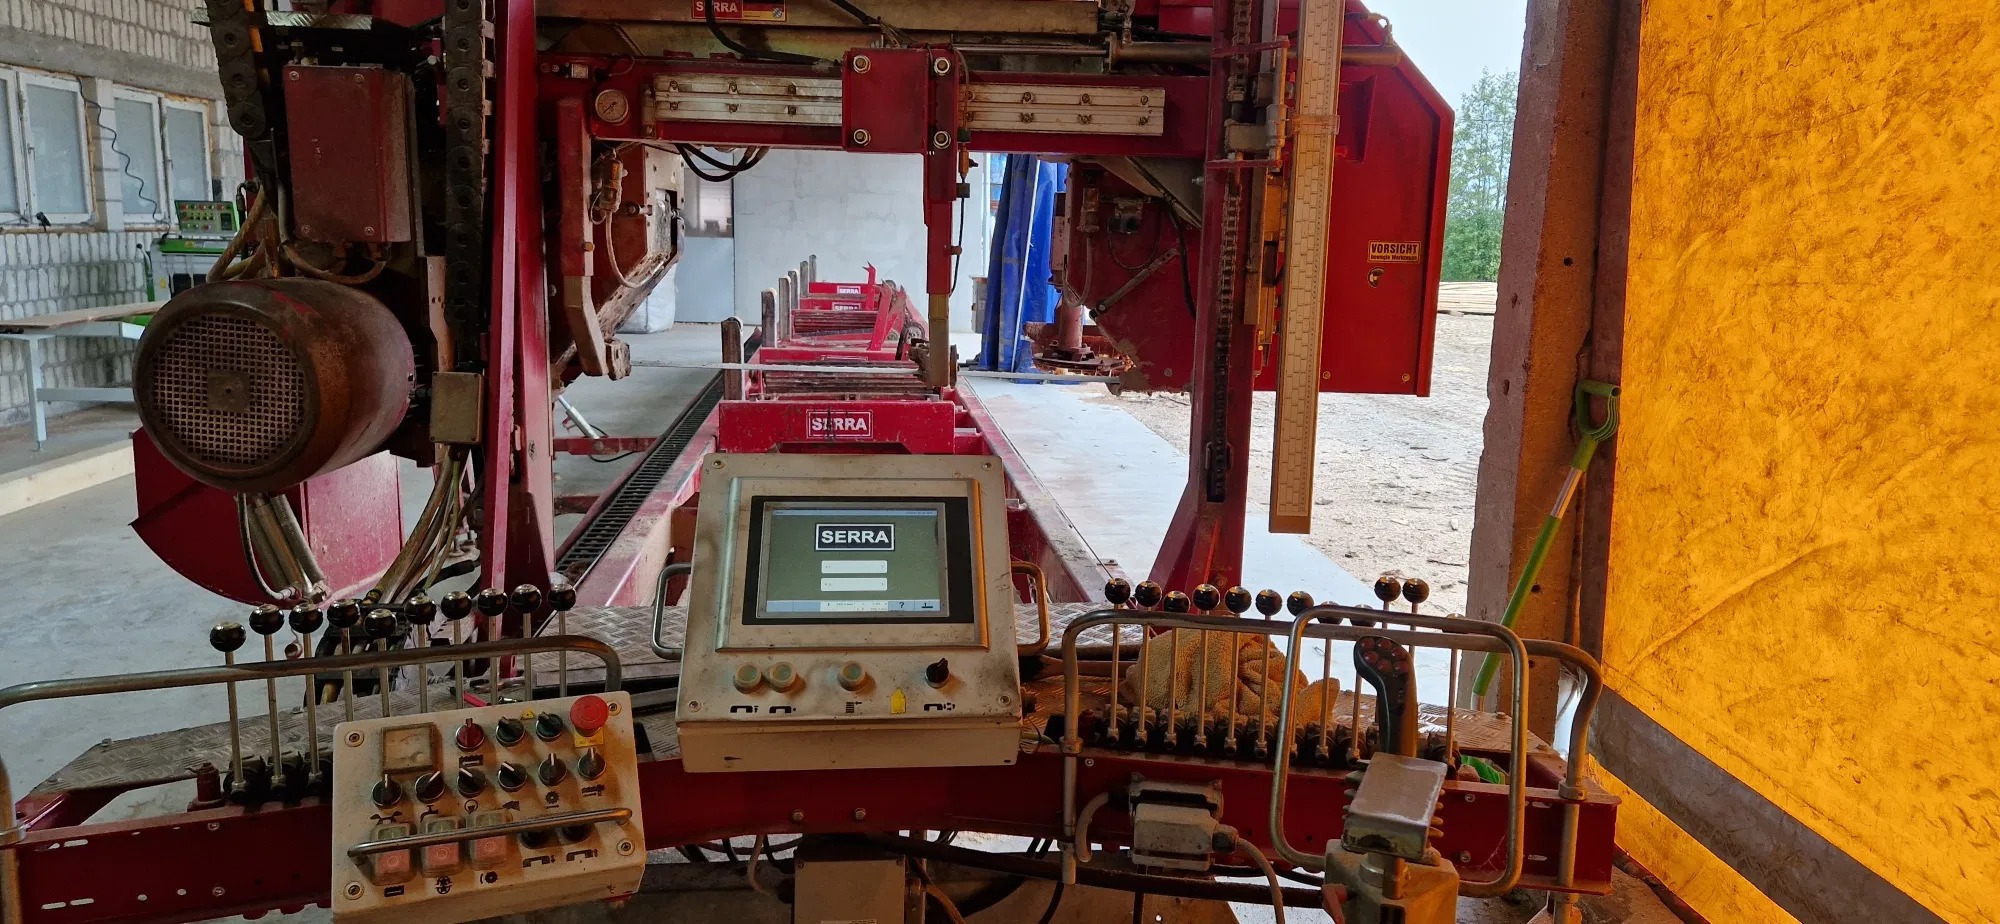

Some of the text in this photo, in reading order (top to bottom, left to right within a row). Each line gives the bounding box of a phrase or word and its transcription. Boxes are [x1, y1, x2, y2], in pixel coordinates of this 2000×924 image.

[696, 2, 738, 12] SRRA
[1371, 244, 1418, 254] VORSICHT
[821, 530, 889, 543] SERRA
